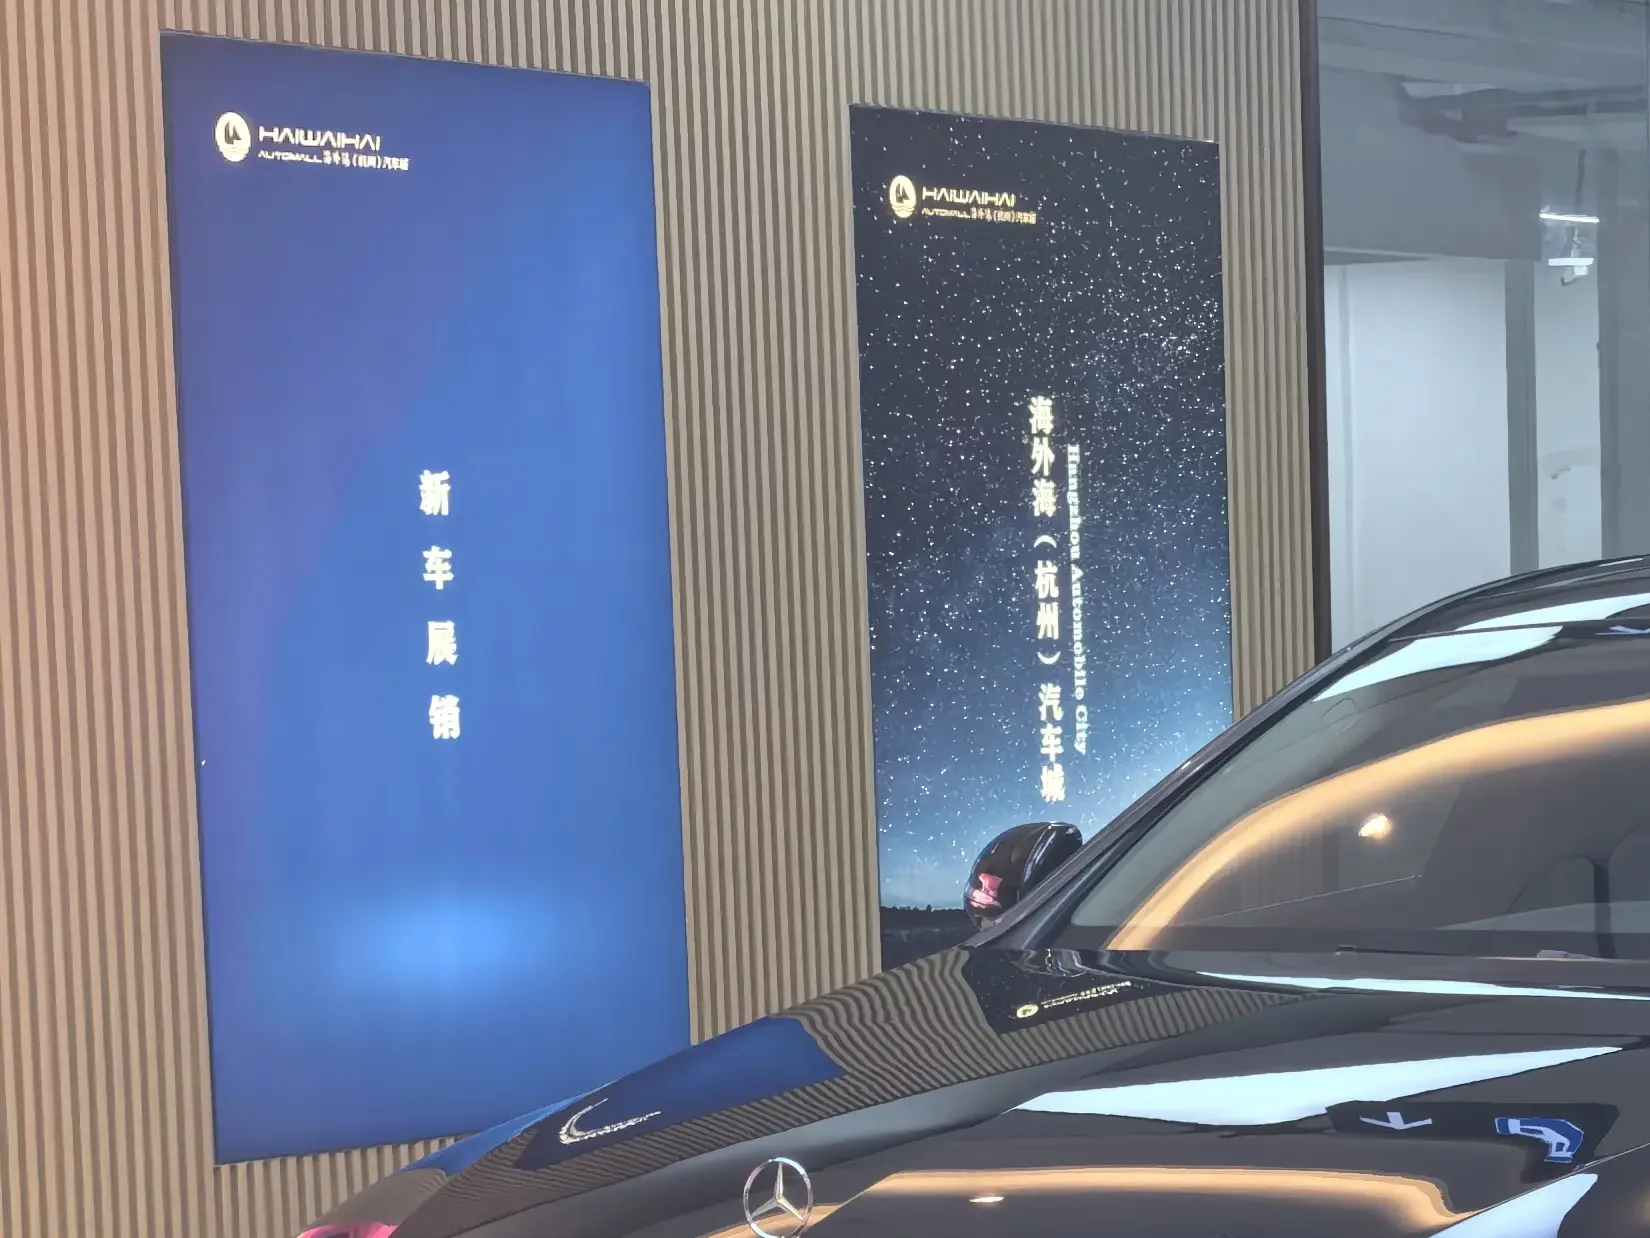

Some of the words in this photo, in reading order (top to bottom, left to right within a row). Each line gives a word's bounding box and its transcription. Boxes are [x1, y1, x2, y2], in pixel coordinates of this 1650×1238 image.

[259, 126, 380, 151] HAIWAIHAI
[923, 186, 1015, 207] HAIWAIHAI
[419, 469, 461, 739] 新车展销
[1074, 704, 1090, 755] City
